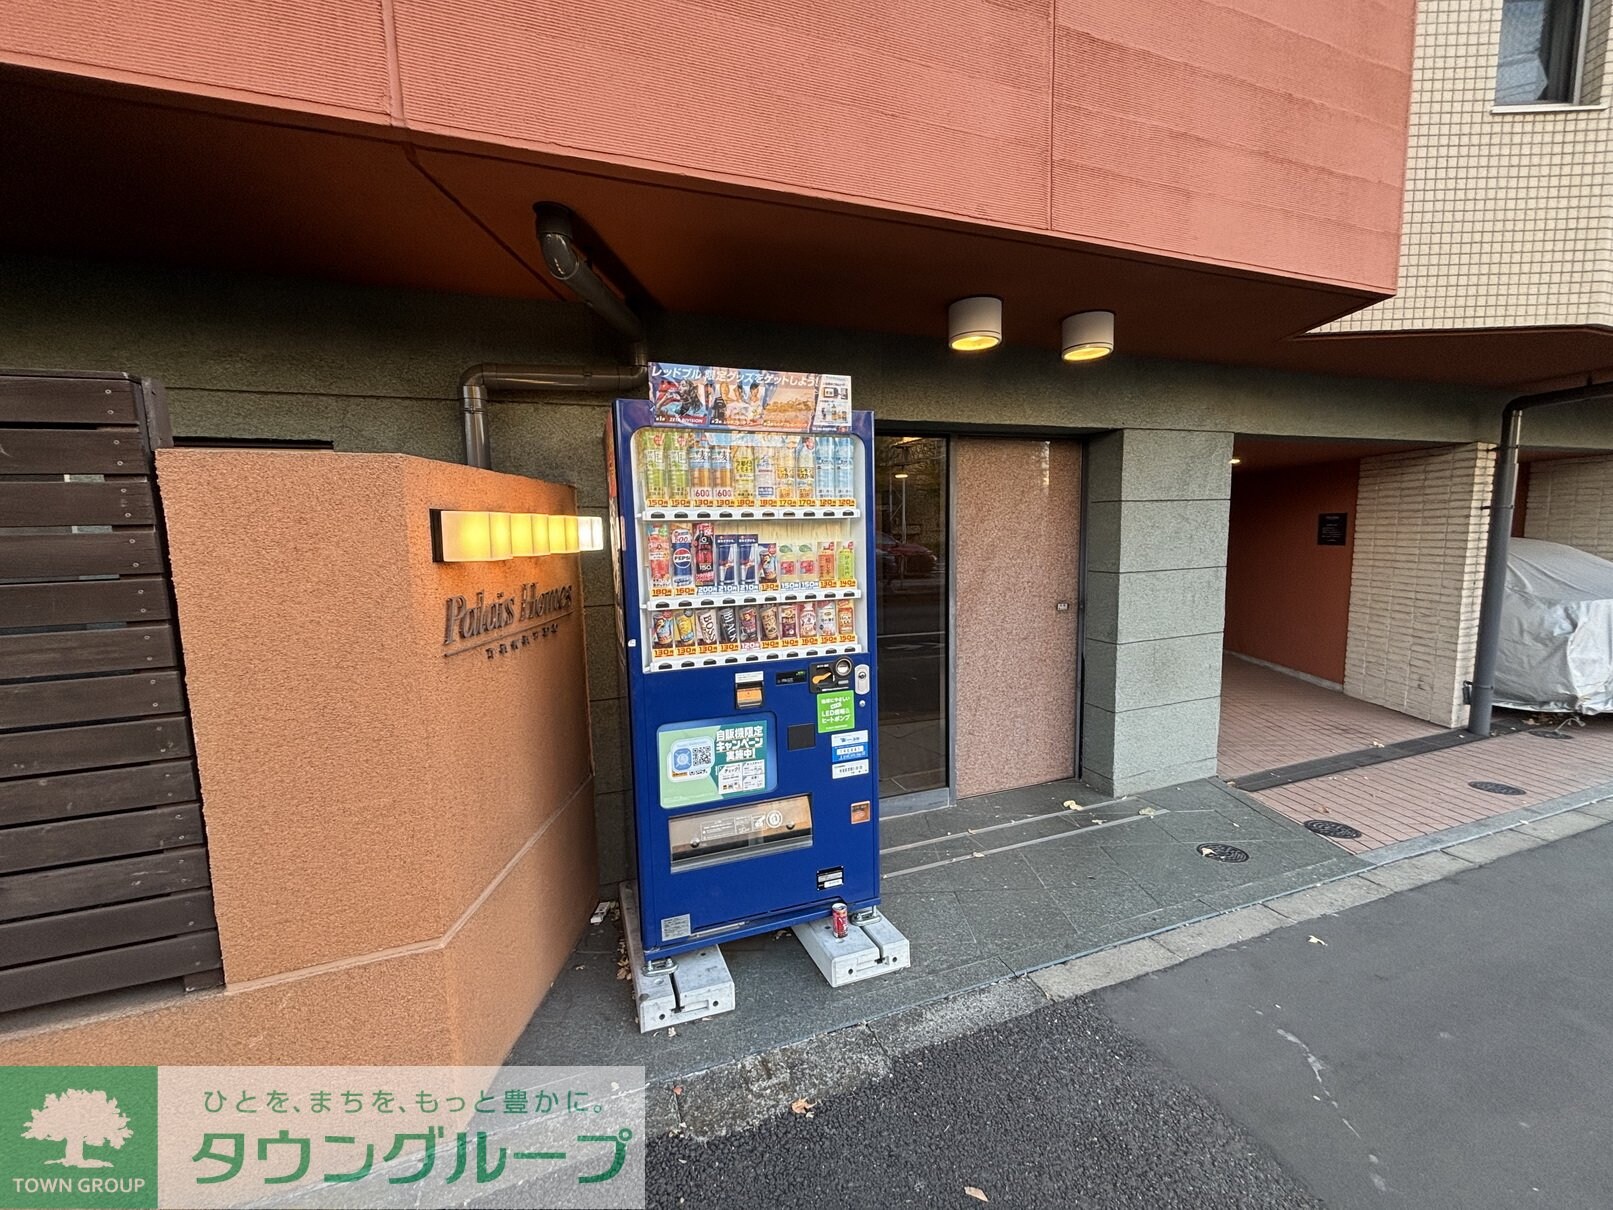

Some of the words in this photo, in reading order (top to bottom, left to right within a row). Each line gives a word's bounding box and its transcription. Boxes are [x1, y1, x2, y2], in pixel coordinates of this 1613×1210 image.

[444, 590, 515, 645] Palais
[520, 582, 573, 622] Homes
[703, 614, 716, 642] BOSS
[716, 726, 763, 741] 自販機限定
[716, 737, 763, 753] キャンペーン
